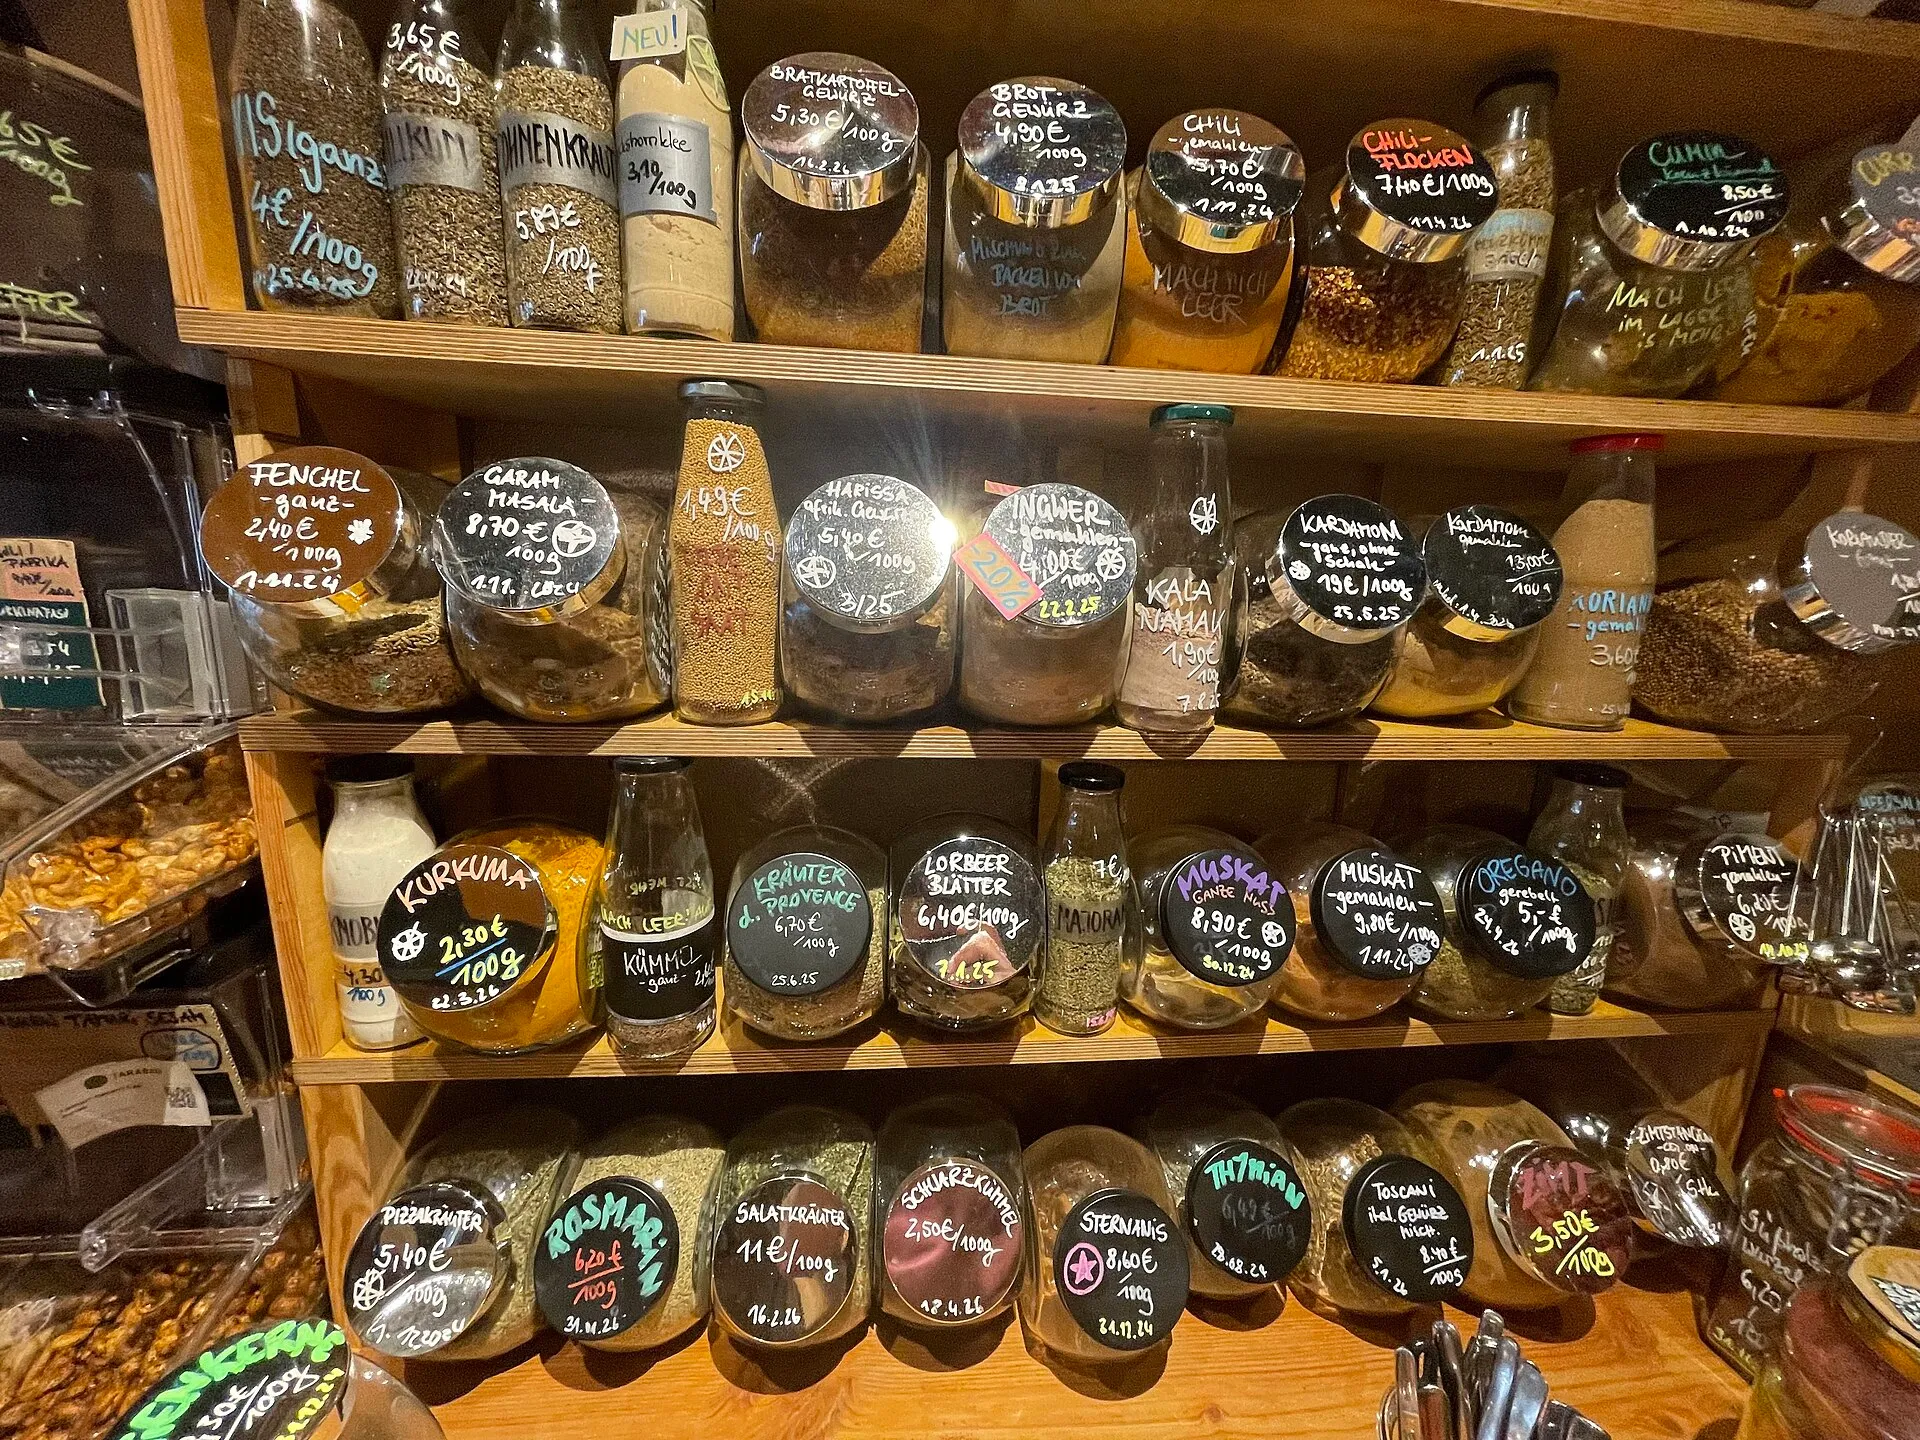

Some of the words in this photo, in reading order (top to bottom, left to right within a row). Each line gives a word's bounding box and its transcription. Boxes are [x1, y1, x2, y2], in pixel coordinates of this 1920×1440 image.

[619, 14, 678, 57] NEU!
[247, 462, 371, 494] FENCHEL
[483, 465, 561, 490] GARAM
[680, 487, 756, 521] 1,49€
[1011, 492, 1111, 527] INGWER
[243, 515, 320, 542] 2,40€
[838, 588, 908, 617] 3/25
[1039, 595, 1102, 619] 22.2.25
[1145, 577, 1214, 609] KALA
[752, 859, 847, 901] KRÄUTER
[923, 851, 1014, 877] LORBEER
[1340, 860, 1422, 891] MUSKAT
[1477, 853, 1578, 897] OREGANO
[395, 854, 533, 914] KURKUMA
[926, 872, 1013, 897] BLÄTTER
[1177, 854, 1287, 907] MUSKAT
[759, 888, 862, 918] PROVENCE
[438, 913, 510, 964] 2,30€
[774, 911, 824, 938] 6,70€
[1190, 906, 1252, 940] 8,90€
[449, 947, 527, 986] 100g
[771, 971, 820, 987] 25.6.25
[735, 1202, 850, 1231] SALATKRÄUTER
[901, 1166, 1019, 1239] SCHWARZKÜMMEL
[1529, 1209, 1600, 1254] 3,50€
[747, 1304, 802, 1329] 16.2.26
